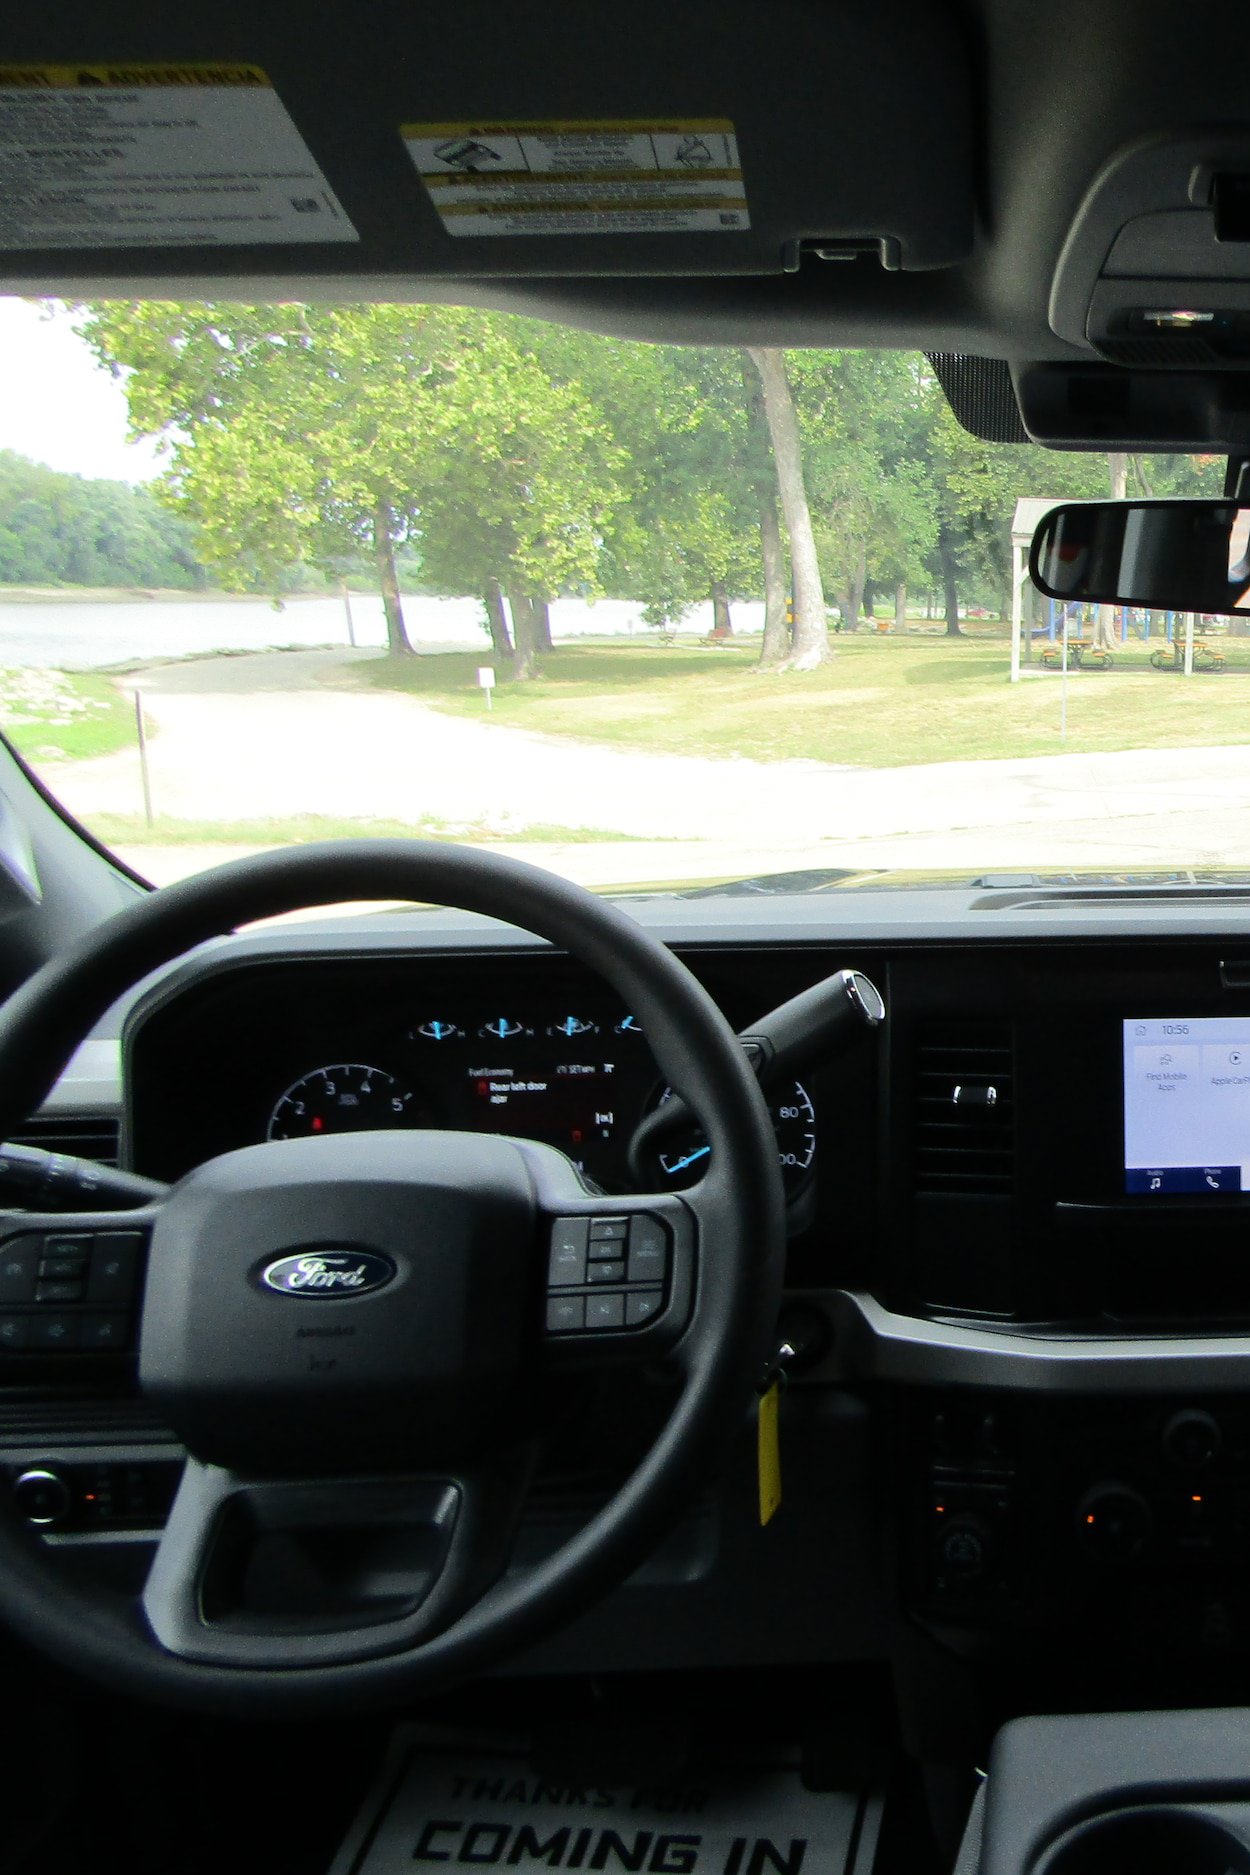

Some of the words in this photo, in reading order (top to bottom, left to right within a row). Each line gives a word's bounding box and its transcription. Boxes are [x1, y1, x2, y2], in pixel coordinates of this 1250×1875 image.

[1162, 1025, 1189, 1035] 10:56
[325, 1080, 337, 1096] 3
[391, 1097, 404, 1112] 5
[779, 1106, 800, 1119] 80
[288, 1256, 368, 1289] Ford
[412, 1820, 703, 1875] COMING
[724, 1836, 808, 1875] IN
